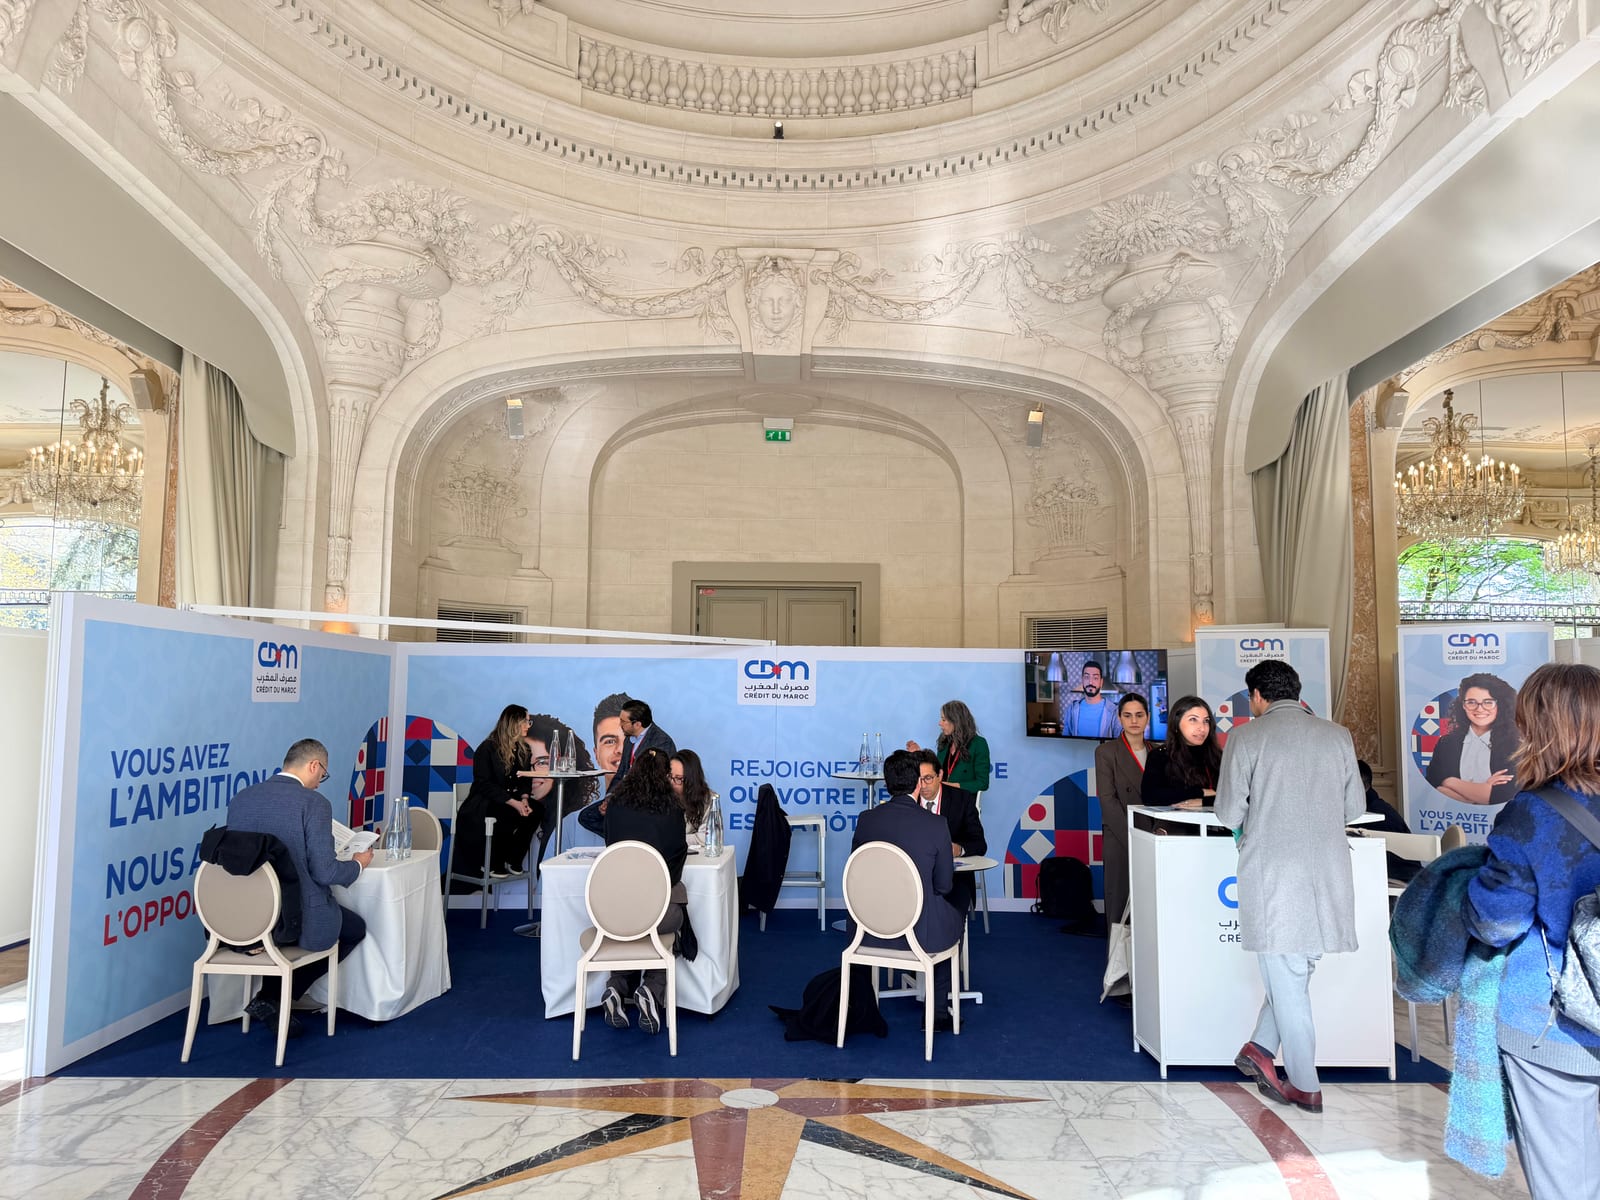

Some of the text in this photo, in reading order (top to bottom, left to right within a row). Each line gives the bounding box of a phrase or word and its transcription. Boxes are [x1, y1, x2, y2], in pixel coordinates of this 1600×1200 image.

[743, 691, 770, 699] CRÉDIT
[110, 742, 230, 780] VOUS AVEZ
[777, 787, 856, 805] VOTRE
[729, 813, 757, 830] ES
[1419, 809, 1488, 823] VOUS AVEZ
[106, 846, 185, 899] NOUS
[103, 889, 198, 947] L'OPPO
[1219, 932, 1242, 943] CRÉ
